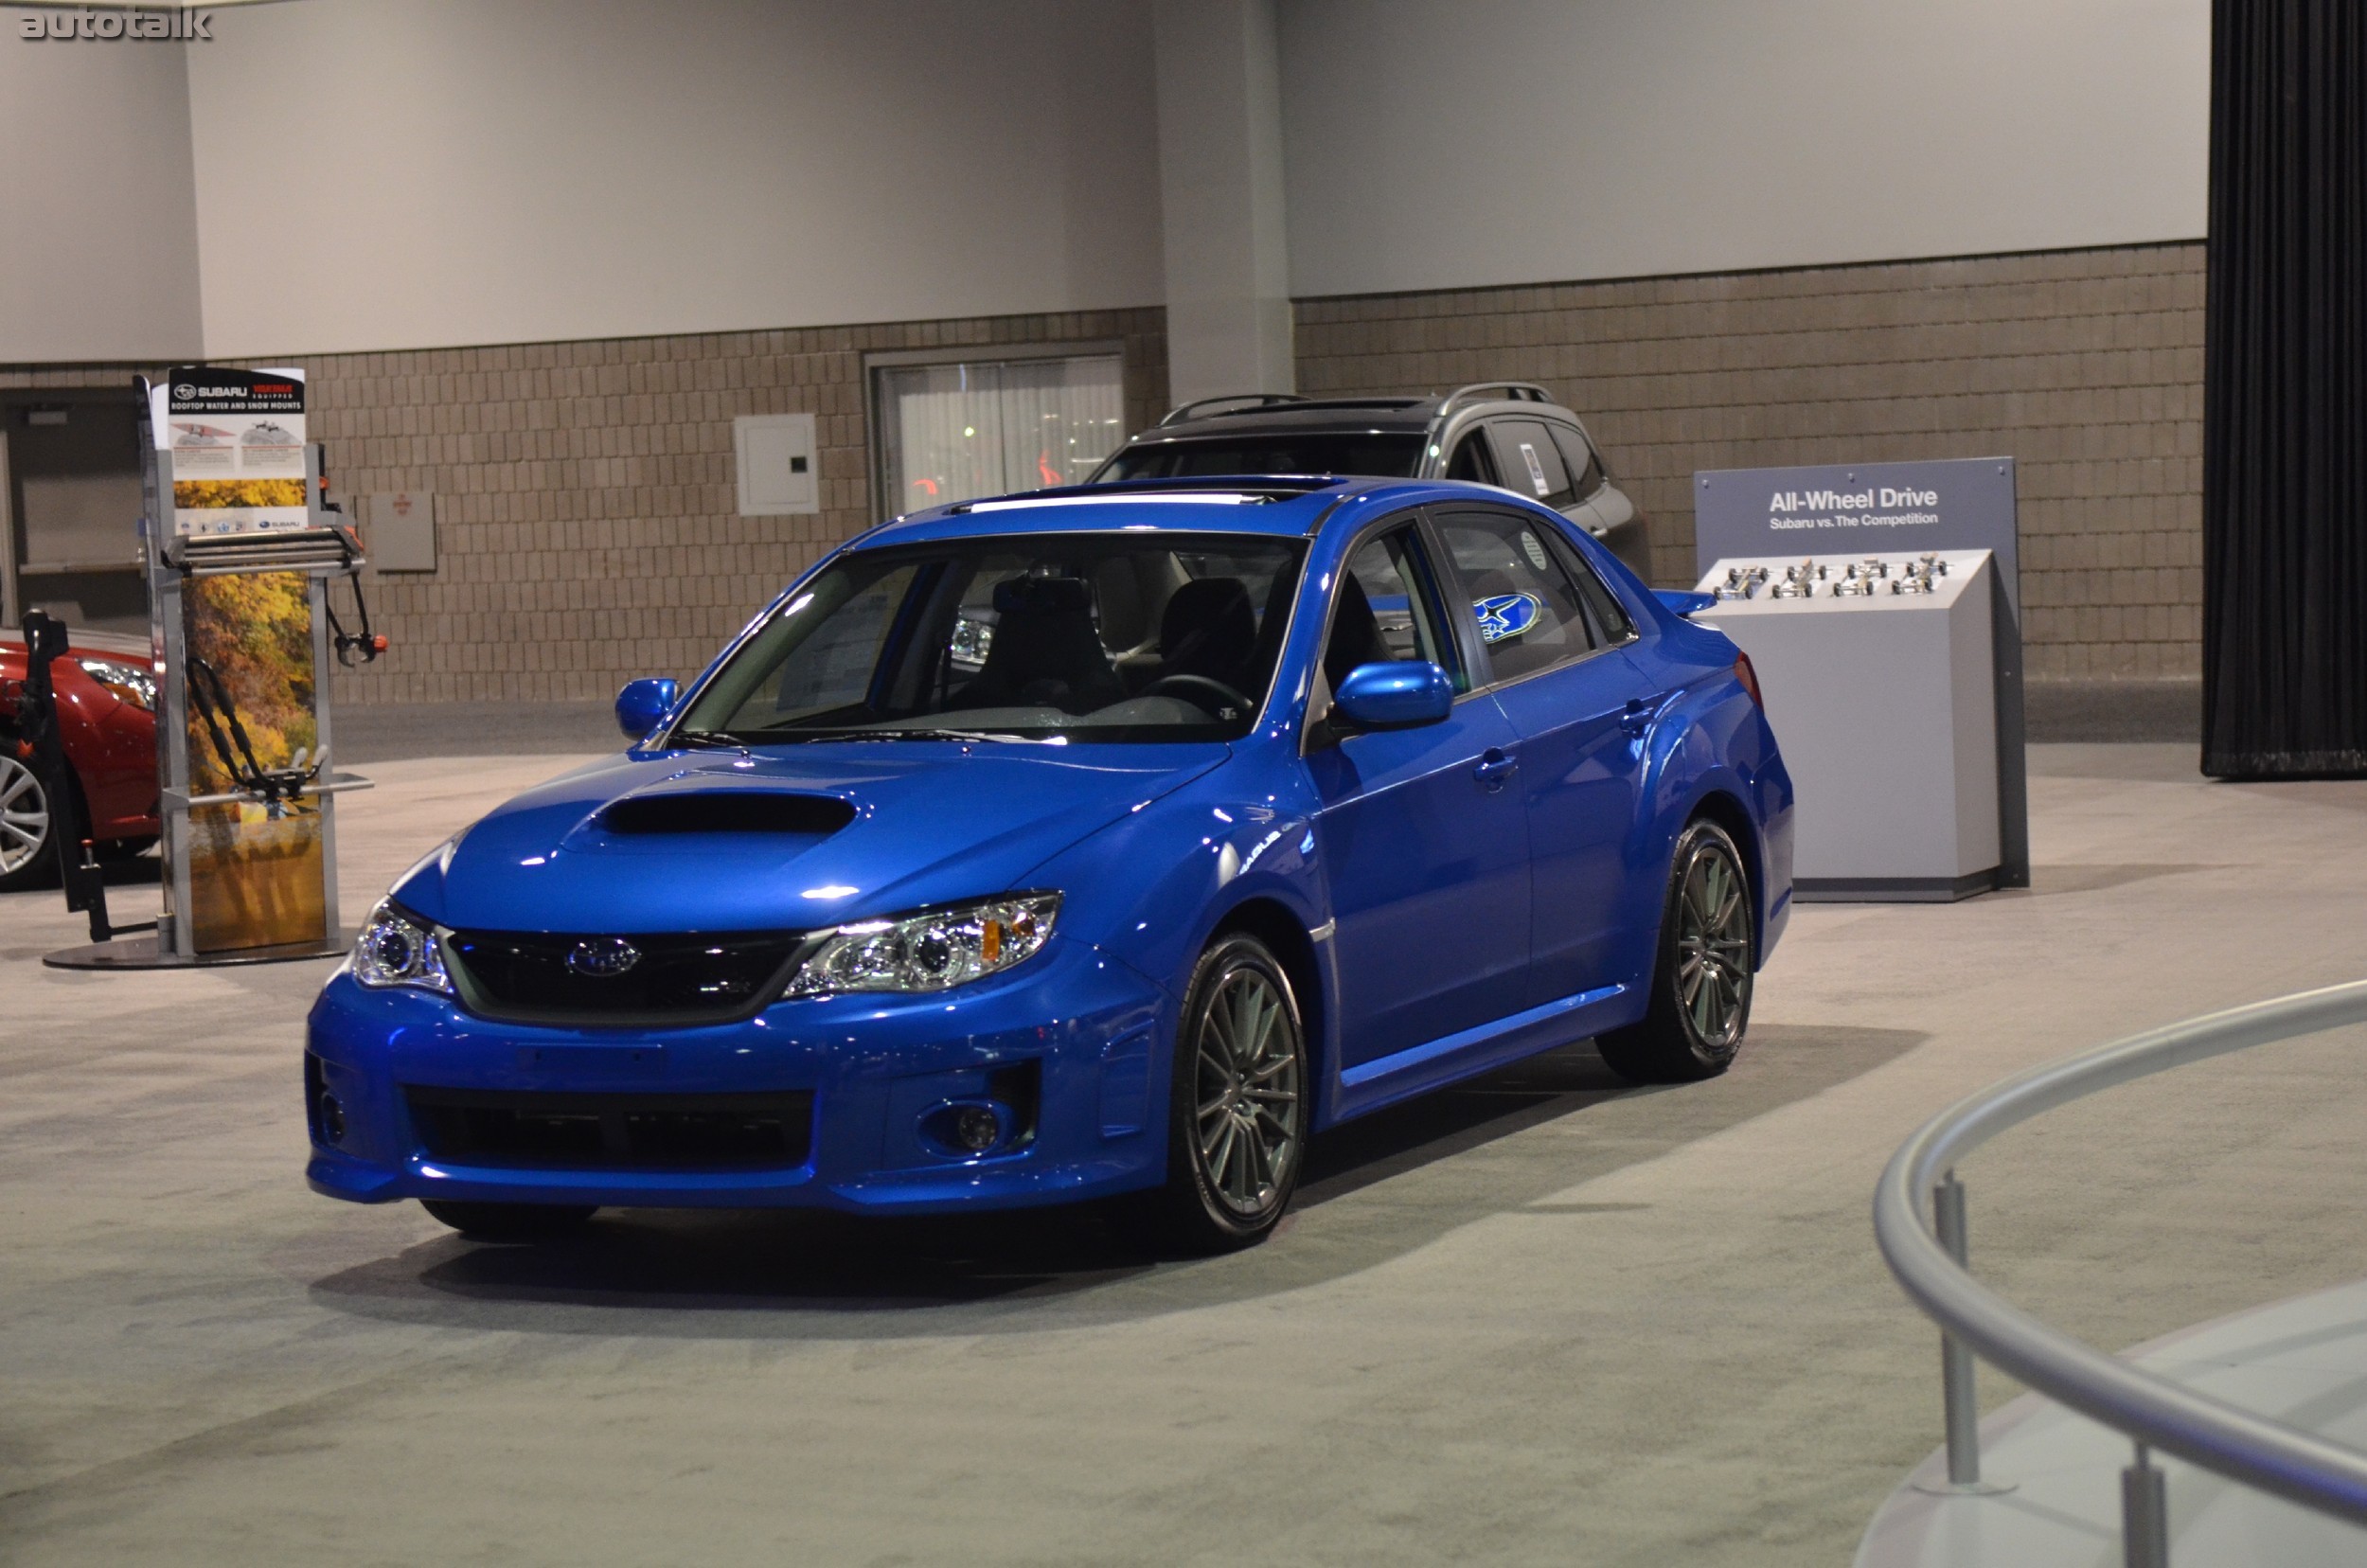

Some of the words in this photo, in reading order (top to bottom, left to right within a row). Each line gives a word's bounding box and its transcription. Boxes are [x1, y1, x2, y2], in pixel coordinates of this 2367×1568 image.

[198, 386, 248, 397] SUBARU
[170, 401, 205, 410] ROOFTOP
[205, 401, 229, 410] WATER
[230, 401, 247, 410] AND
[247, 401, 269, 410] SNOW
[270, 401, 302, 410] MOUNTS
[1770, 489, 1875, 512] All-Wheel
[1879, 487, 1939, 508] Drive
[1770, 517, 1815, 529] Subaru
[1816, 518, 1835, 528] vs.
[1834, 515, 1860, 527] The
[1860, 512, 1939, 527] Competition
